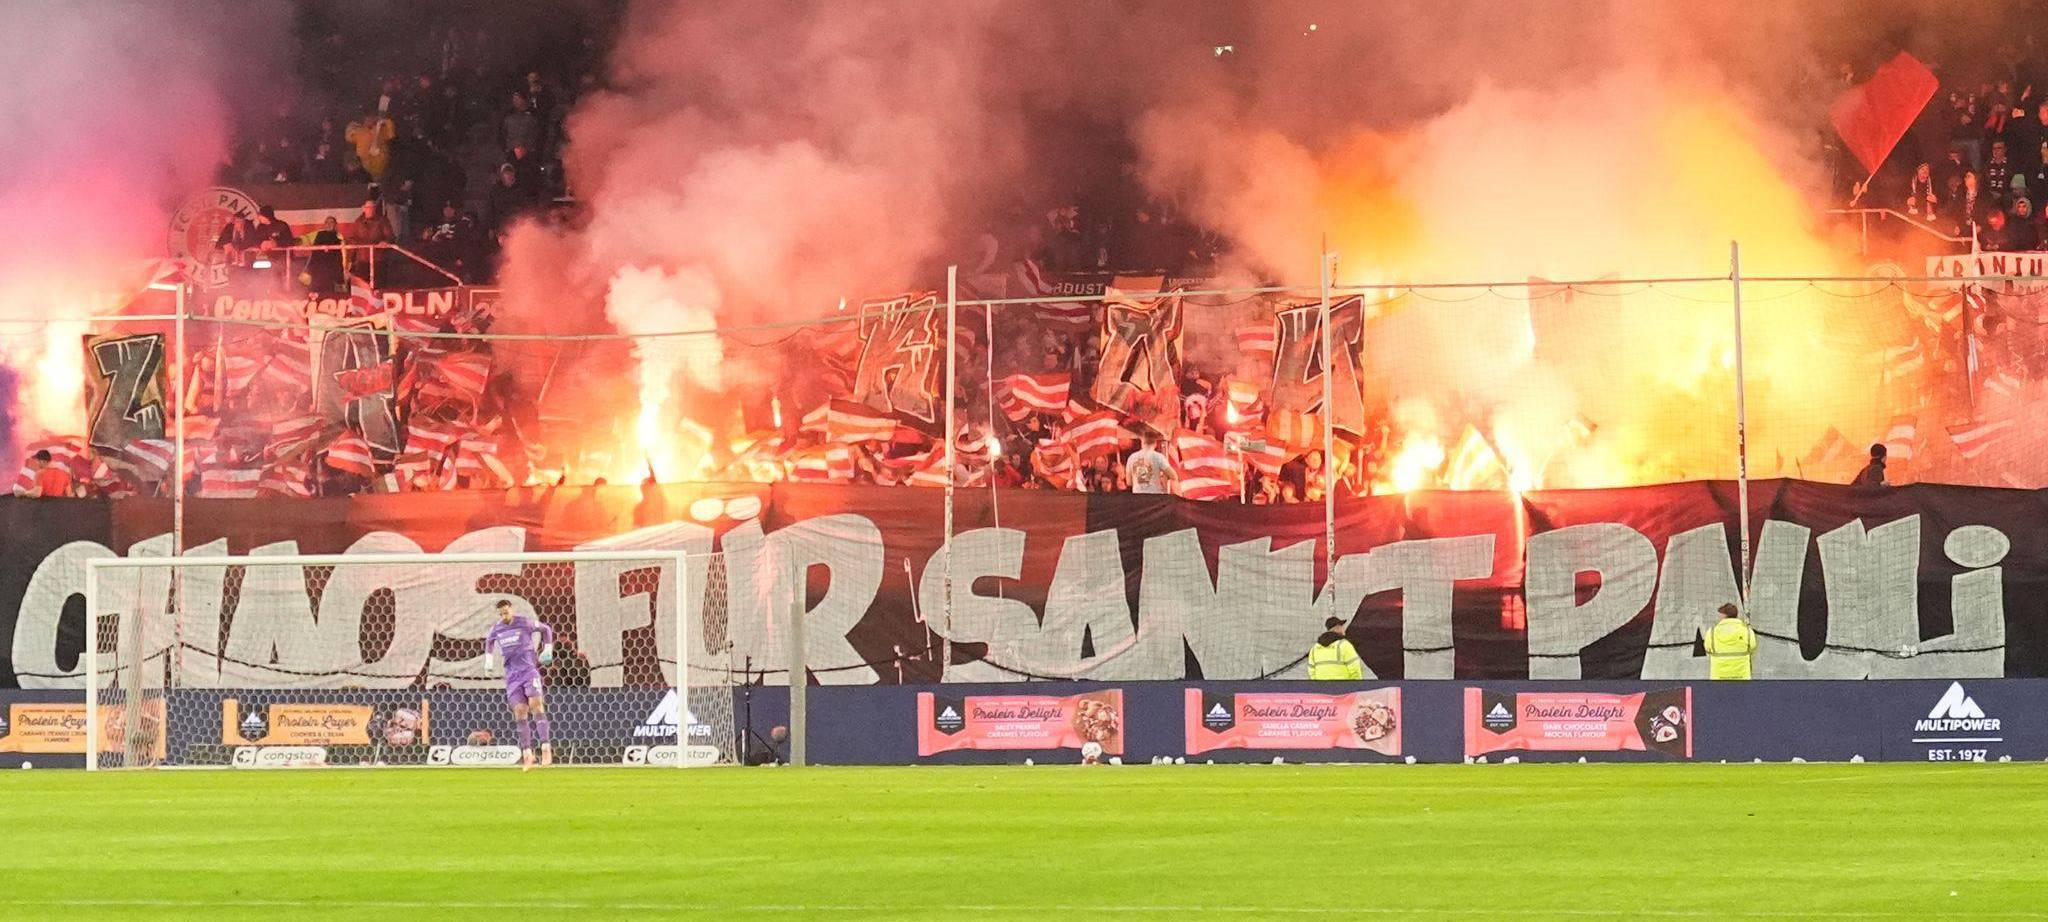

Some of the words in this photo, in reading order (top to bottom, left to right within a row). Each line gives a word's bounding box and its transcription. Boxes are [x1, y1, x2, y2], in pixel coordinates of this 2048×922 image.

[12, 526, 540, 689] CHAOS
[918, 526, 1497, 682] SANKT
[973, 706, 1015, 719] Protein
[1018, 701, 1063, 721] Delight
[1243, 704, 1288, 718] Protein
[1290, 700, 1338, 721] Delight
[1525, 704, 1572, 718] Protein
[1575, 699, 1625, 721] Delight
[18, 713, 59, 726] Protein
[277, 714, 319, 727] Protein
[322, 714, 357, 730] Layer
[1914, 718, 2001, 732] MULTIPOWER
[633, 724, 712, 737] MULTIPWER
[458, 750, 515, 761] congstar
[1928, 749, 1956, 761] EST.
[1958, 749, 1988, 761] 1977
